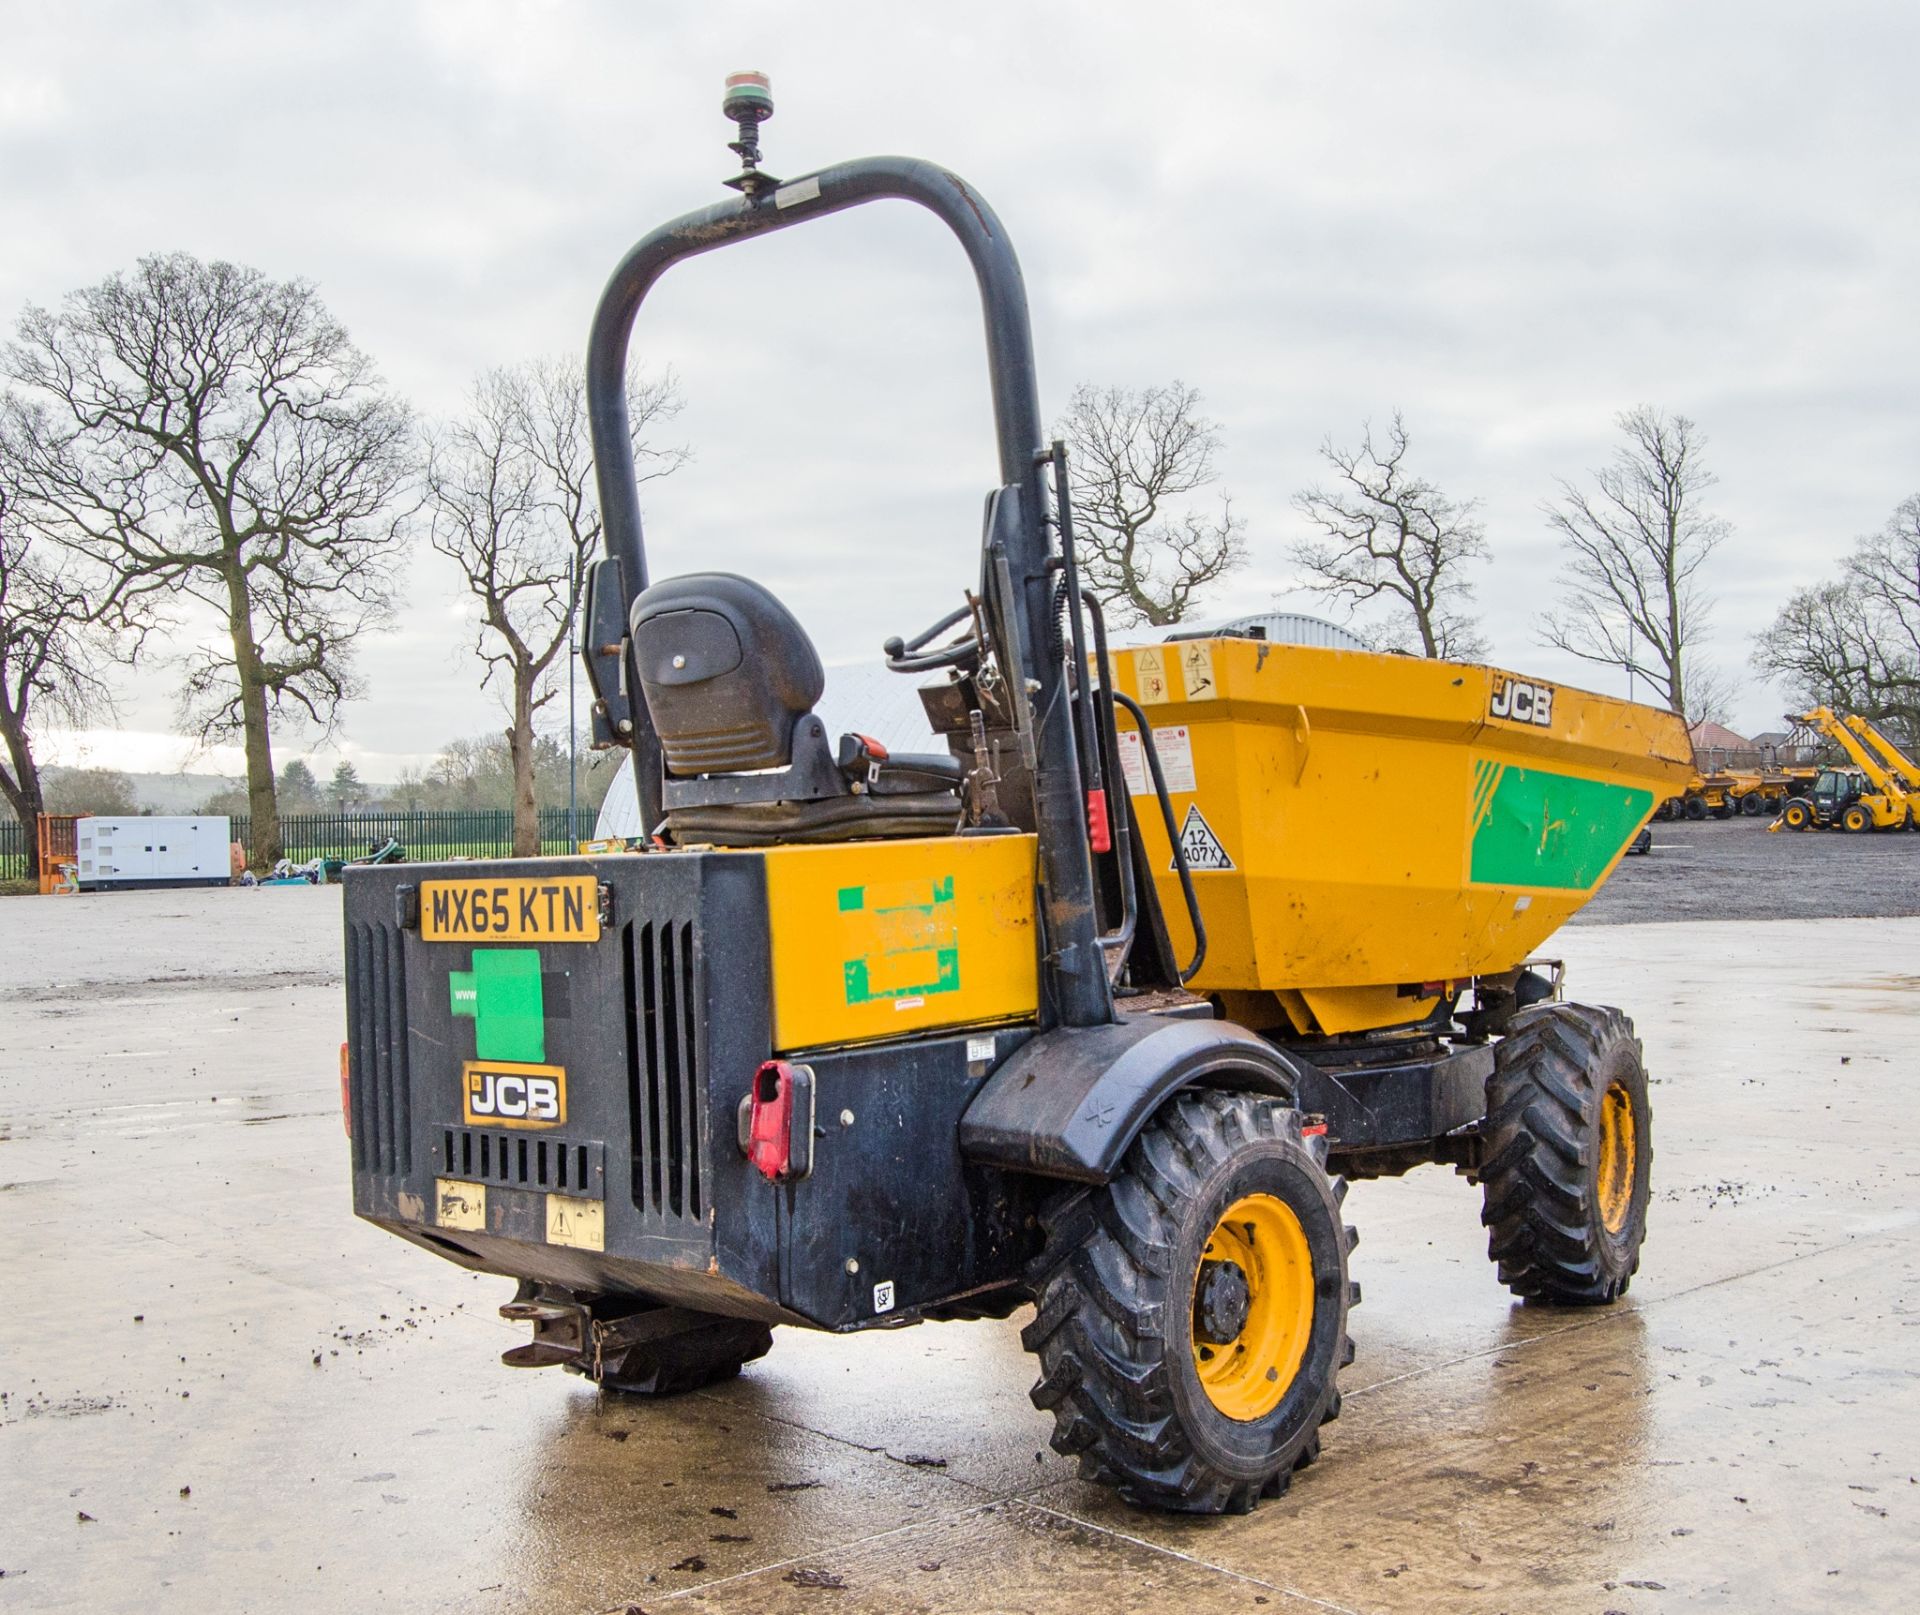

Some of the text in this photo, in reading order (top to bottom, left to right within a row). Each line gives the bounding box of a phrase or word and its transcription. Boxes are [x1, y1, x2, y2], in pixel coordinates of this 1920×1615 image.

[1491, 680, 1552, 725] JCB
[1189, 829, 1207, 846] 12
[432, 885, 584, 933] MX65 KTN
[471, 1075, 559, 1119] JCB
